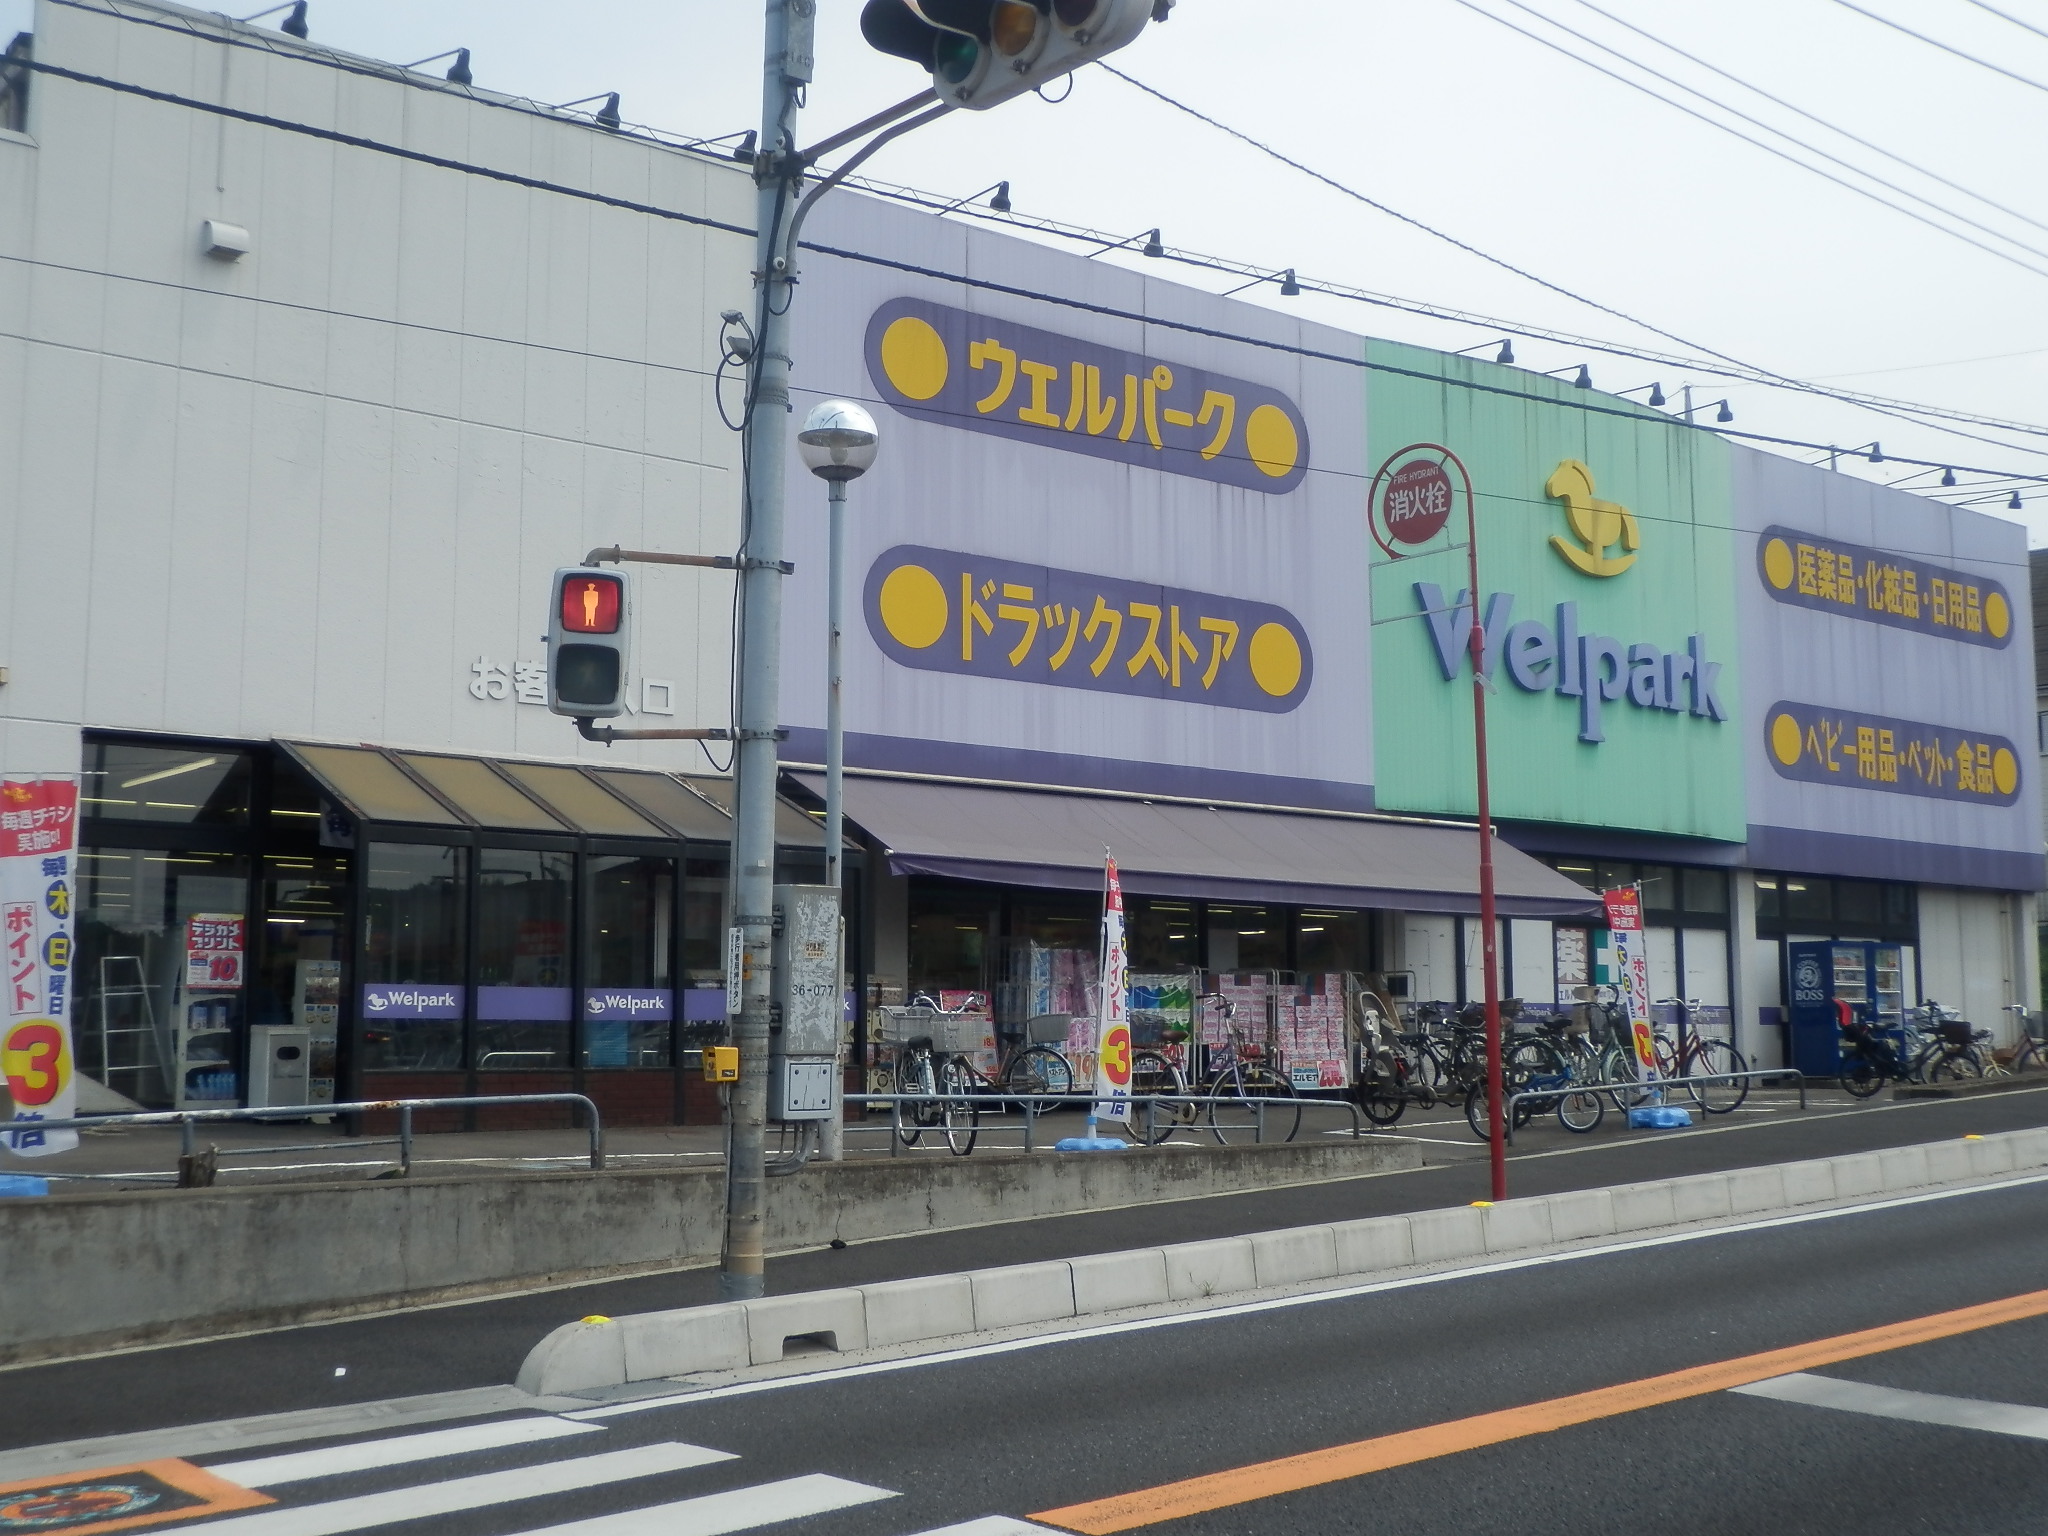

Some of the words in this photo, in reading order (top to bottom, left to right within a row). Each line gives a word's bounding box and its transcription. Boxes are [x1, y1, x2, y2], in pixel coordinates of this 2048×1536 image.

[1393, 474, 1408, 485] FIRE
[1409, 466, 1440, 481] HYDRANT
[1389, 480, 1448, 523] 消火栓
[1796, 542, 1983, 633] 医薬品・化粧品・日用品
[1412, 581, 1729, 744] Welpark
[1, 806, 74, 831] 毎週チラシ
[7, 905, 36, 1011] ポイント
[1556, 928, 1588, 981] 薬
[387, 991, 456, 1013] Welpark
[605, 995, 665, 1015] Welpark
[791, 983, 834, 997] 36-077
[1795, 989, 1824, 1001] BOSS
[7, 1024, 62, 1106] 3
[1105, 1027, 1131, 1086] 3
